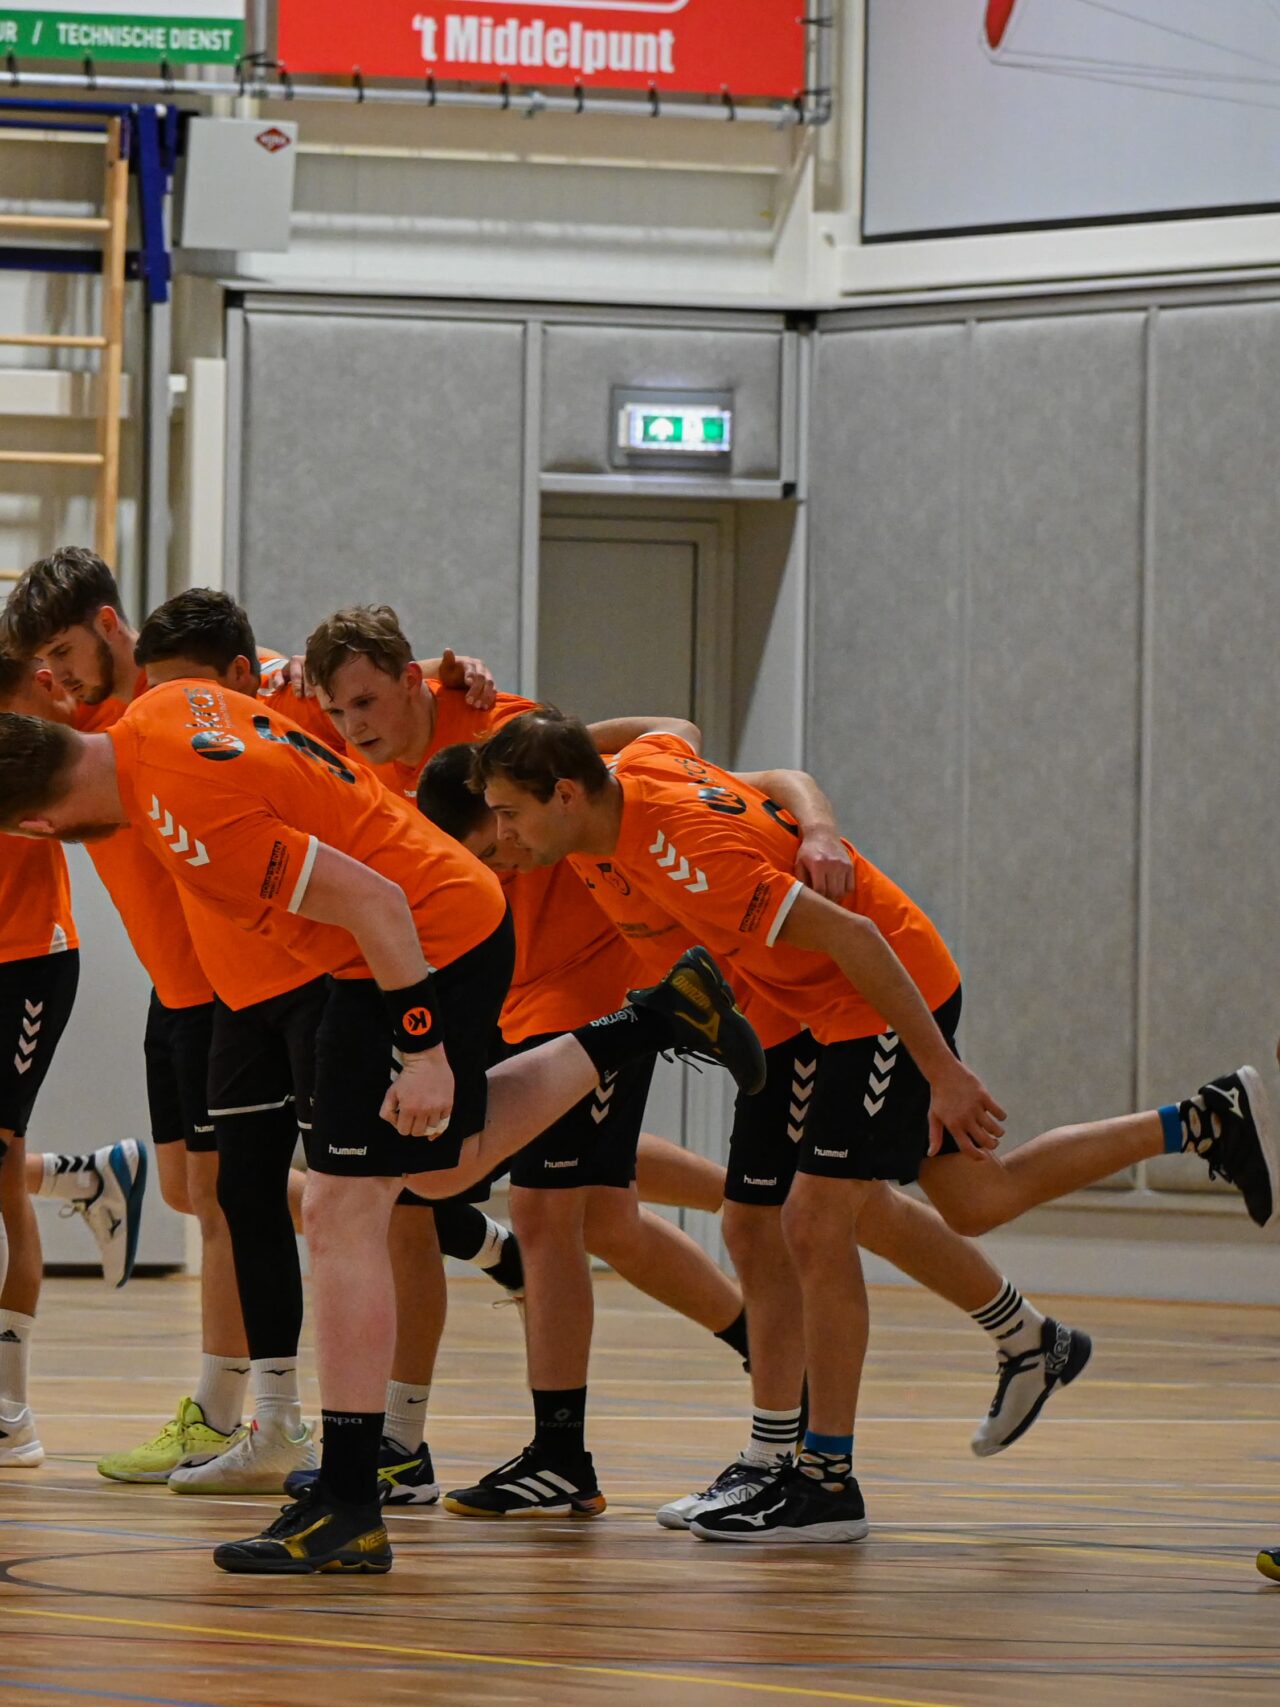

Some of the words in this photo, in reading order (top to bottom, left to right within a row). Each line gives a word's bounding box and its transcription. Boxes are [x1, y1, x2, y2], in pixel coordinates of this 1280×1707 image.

[57, 22, 167, 49] TECHNISCHE
[170, 28, 233, 51] DIENST
[444, 15, 675, 74] Middelpunt
[328, 1144, 367, 1157] hummel
[814, 1146, 848, 1159] hummel
[544, 1157, 578, 1169] hummel
[743, 1174, 777, 1186] hummel
